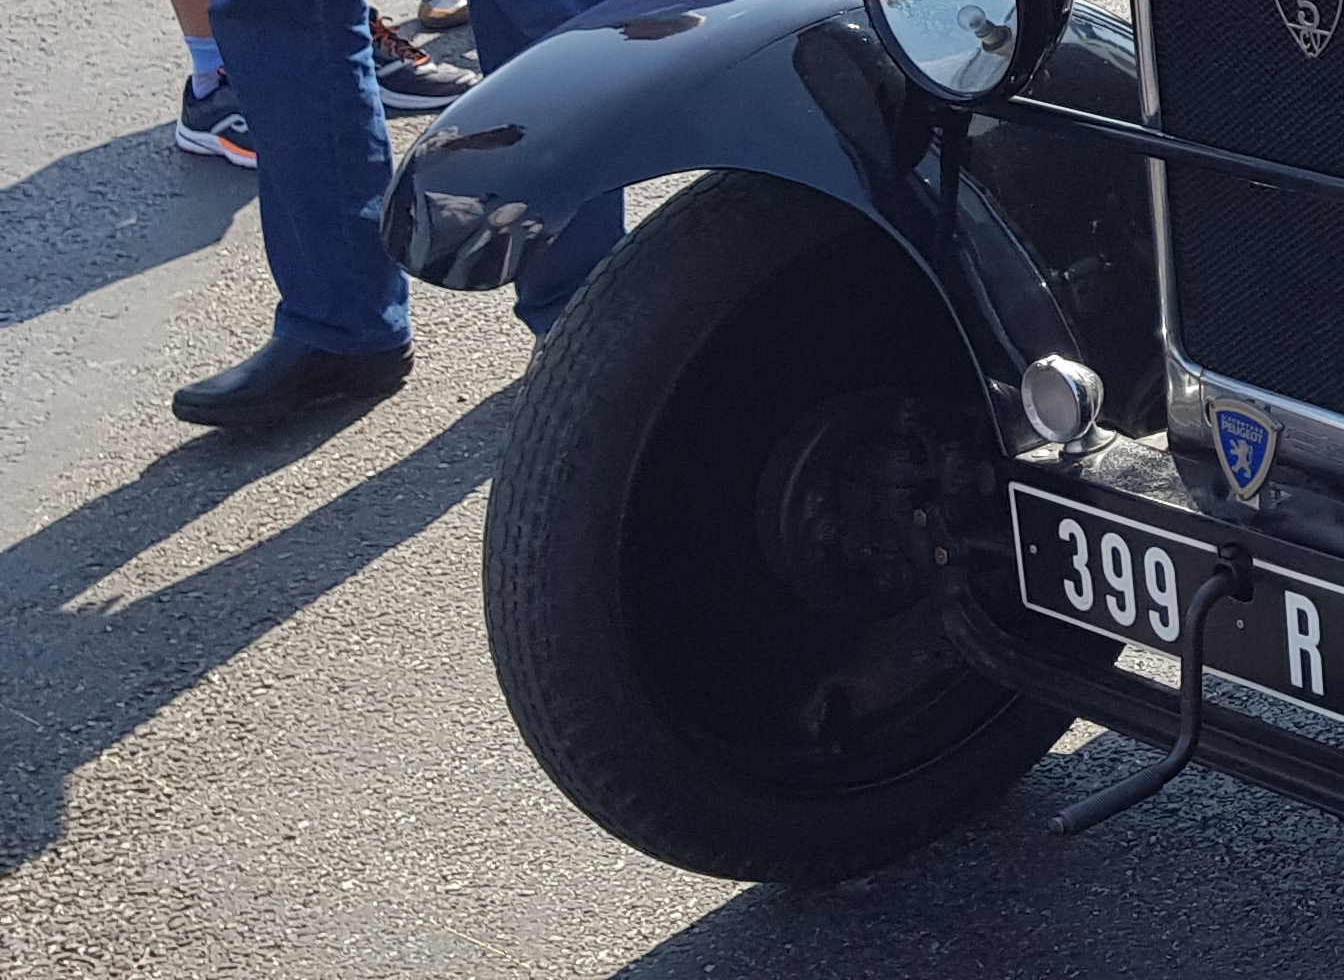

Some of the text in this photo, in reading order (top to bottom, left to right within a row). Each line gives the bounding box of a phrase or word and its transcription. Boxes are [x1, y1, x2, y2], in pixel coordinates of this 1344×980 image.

[1221, 420, 1264, 445] PEUGEOT
[1058, 518, 1180, 642] 399
[1284, 590, 1325, 696] R
